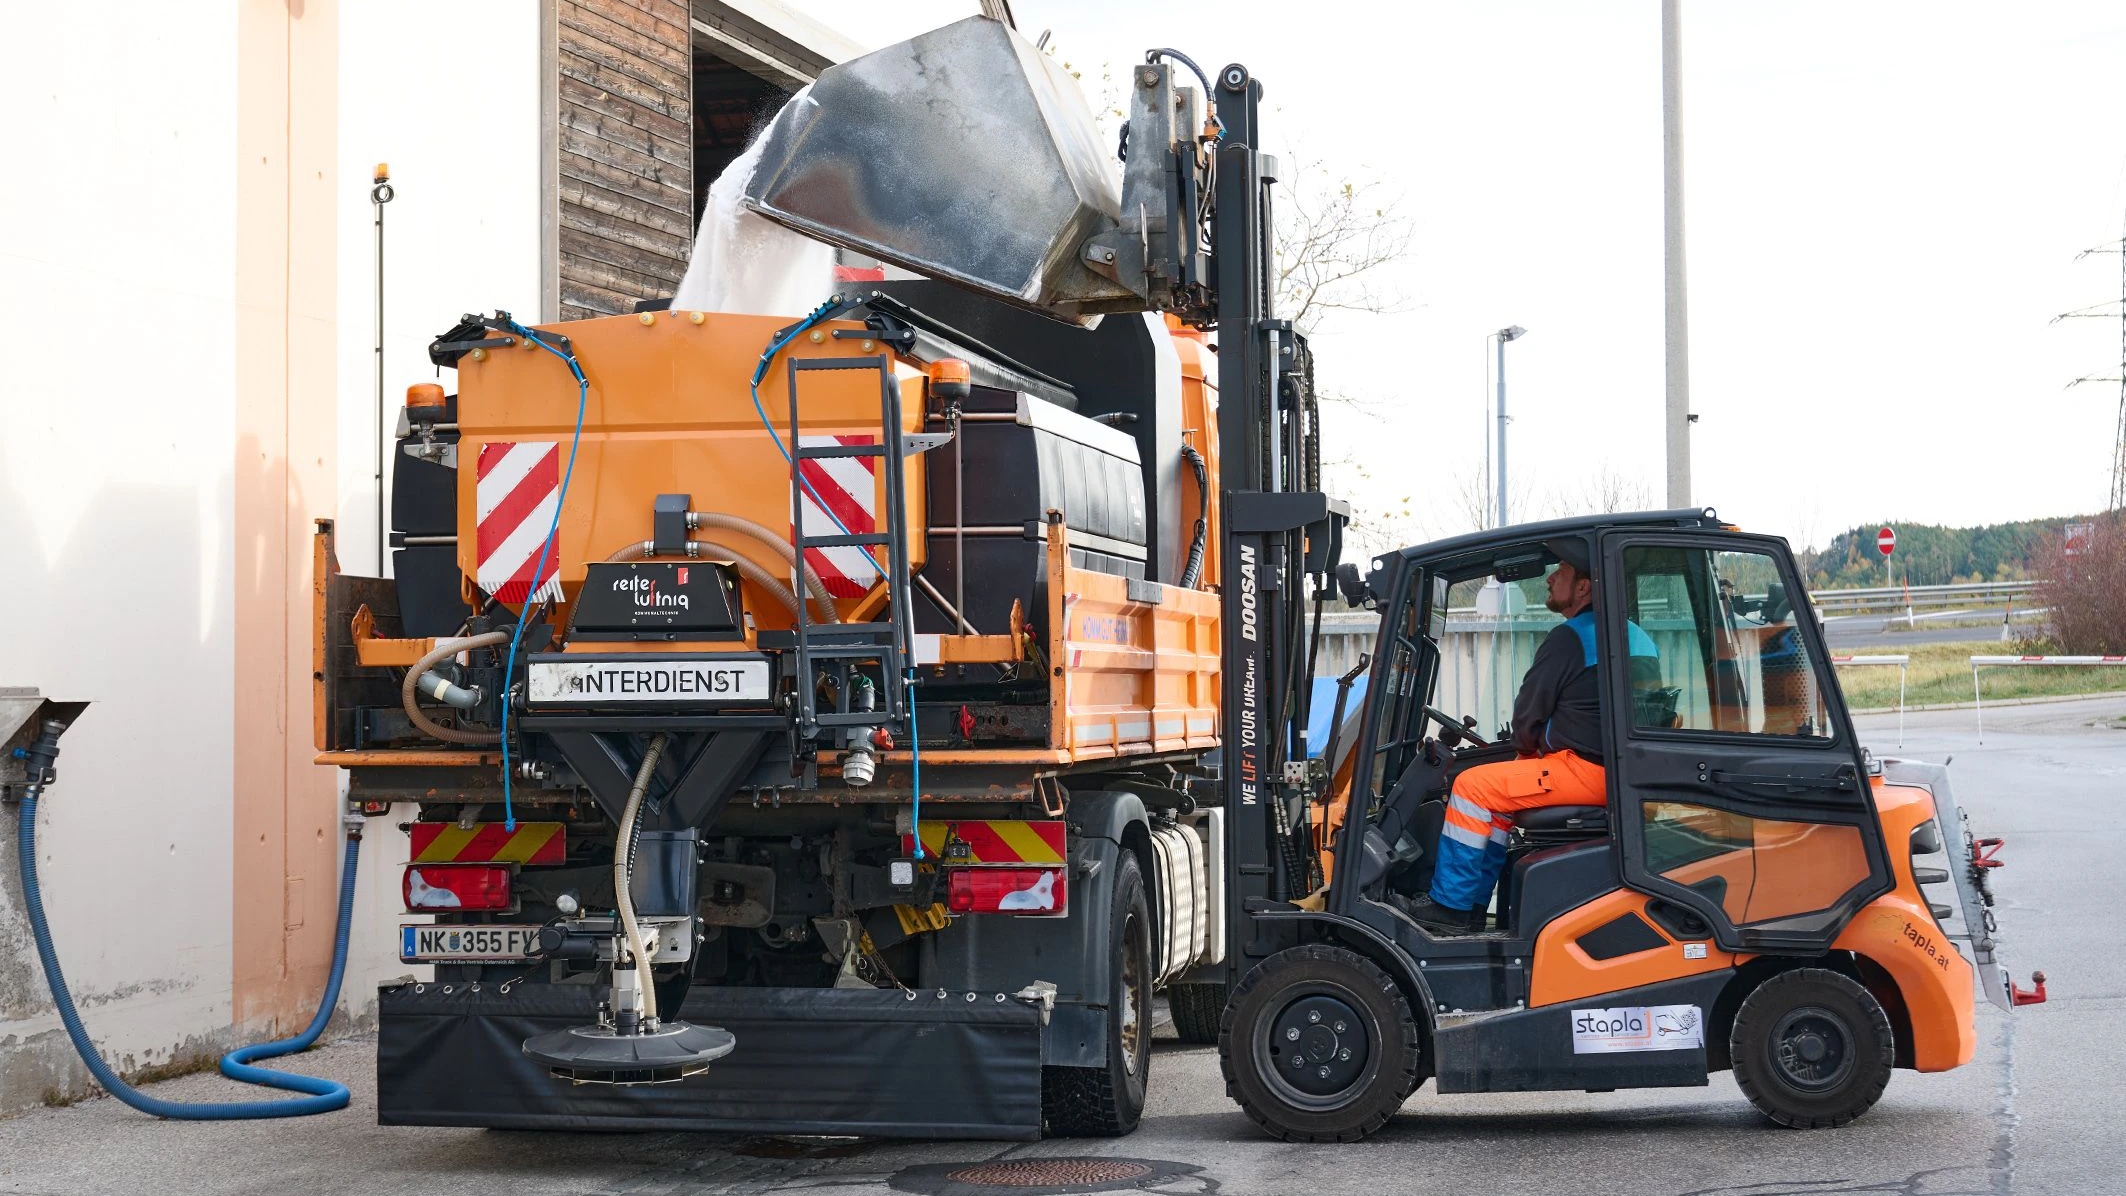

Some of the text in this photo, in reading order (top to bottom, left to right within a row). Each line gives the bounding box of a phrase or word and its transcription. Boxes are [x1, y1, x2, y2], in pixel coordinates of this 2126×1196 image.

[612, 574, 656, 591] reiter
[1240, 544, 1257, 642] DOOSAN
[568, 670, 745, 693] INTERDIENST
[1241, 710, 1256, 748] YOUR
[1242, 783, 1257, 805] WE
[406, 945, 413, 953] A
[420, 931, 446, 953] NK
[462, 930, 502, 953] 355
[1903, 922, 1950, 971] tapla.at
[1575, 1011, 1643, 1037] stapla
